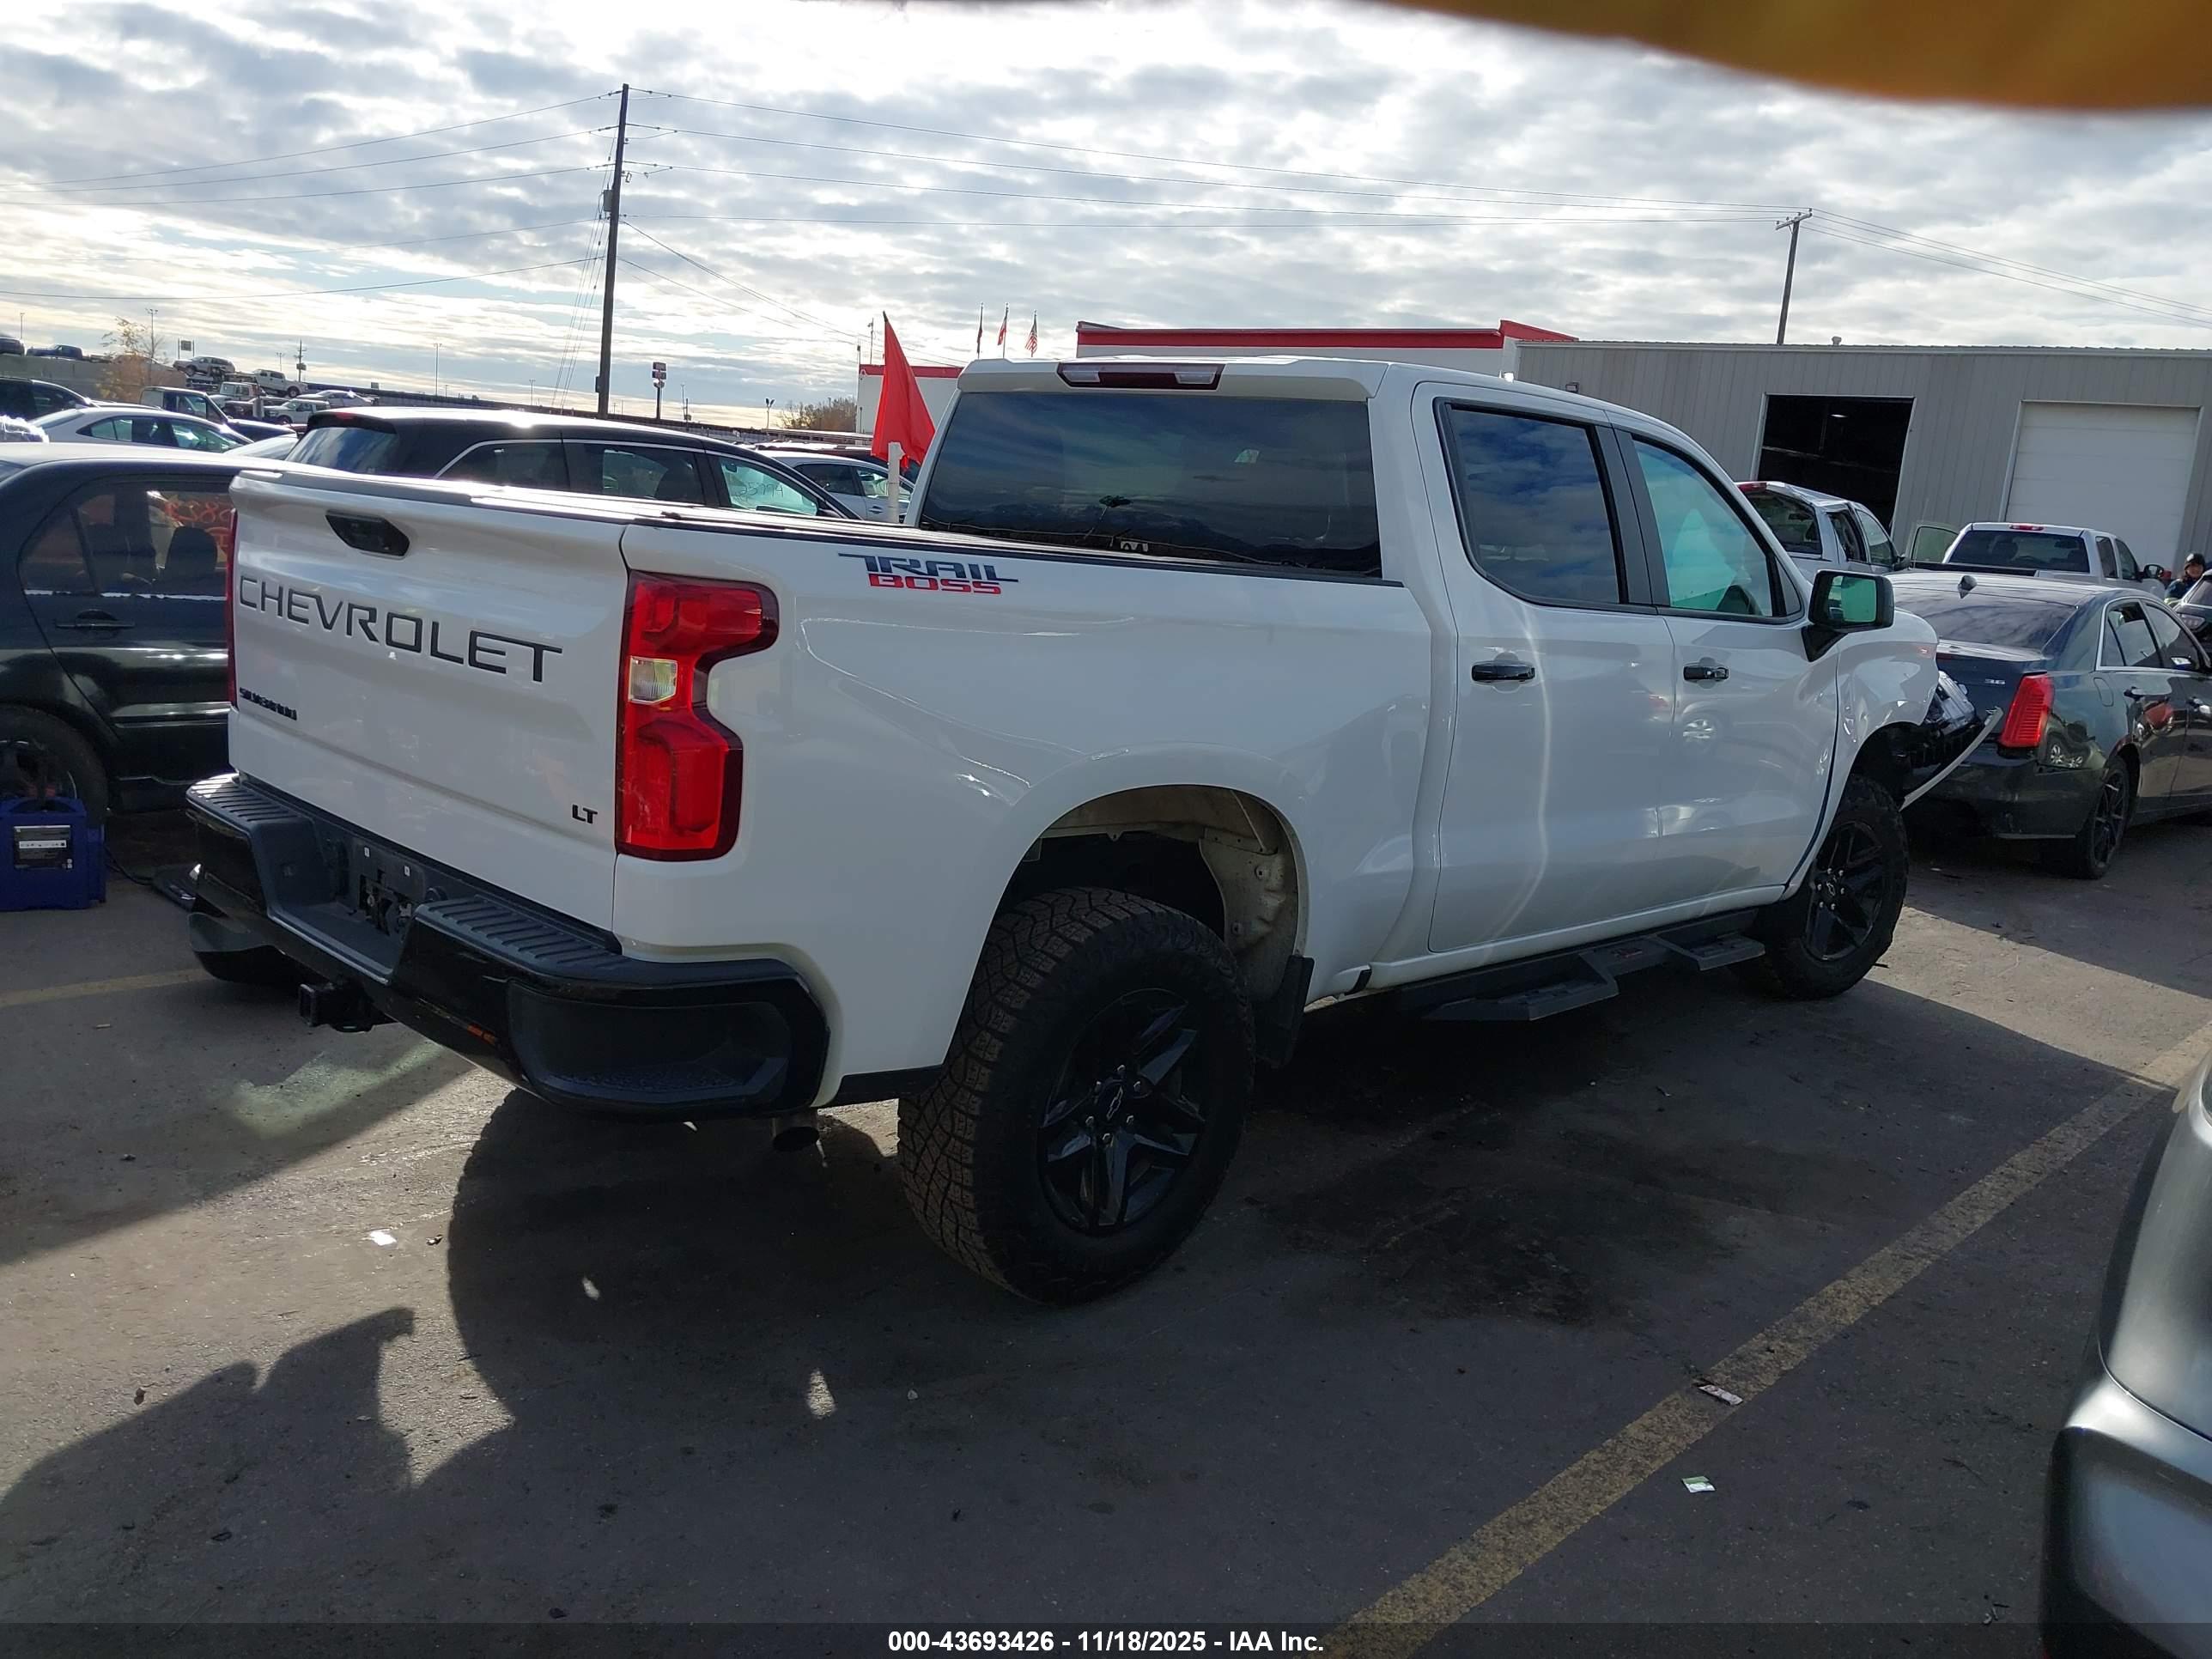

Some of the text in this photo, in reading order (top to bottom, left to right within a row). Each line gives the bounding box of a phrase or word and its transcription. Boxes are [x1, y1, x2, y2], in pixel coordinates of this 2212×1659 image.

[838, 552, 1019, 583] TRAIL
[868, 573, 1002, 595] BOSS
[240, 574, 563, 683] CHEVROLET
[572, 803, 599, 825] LT
